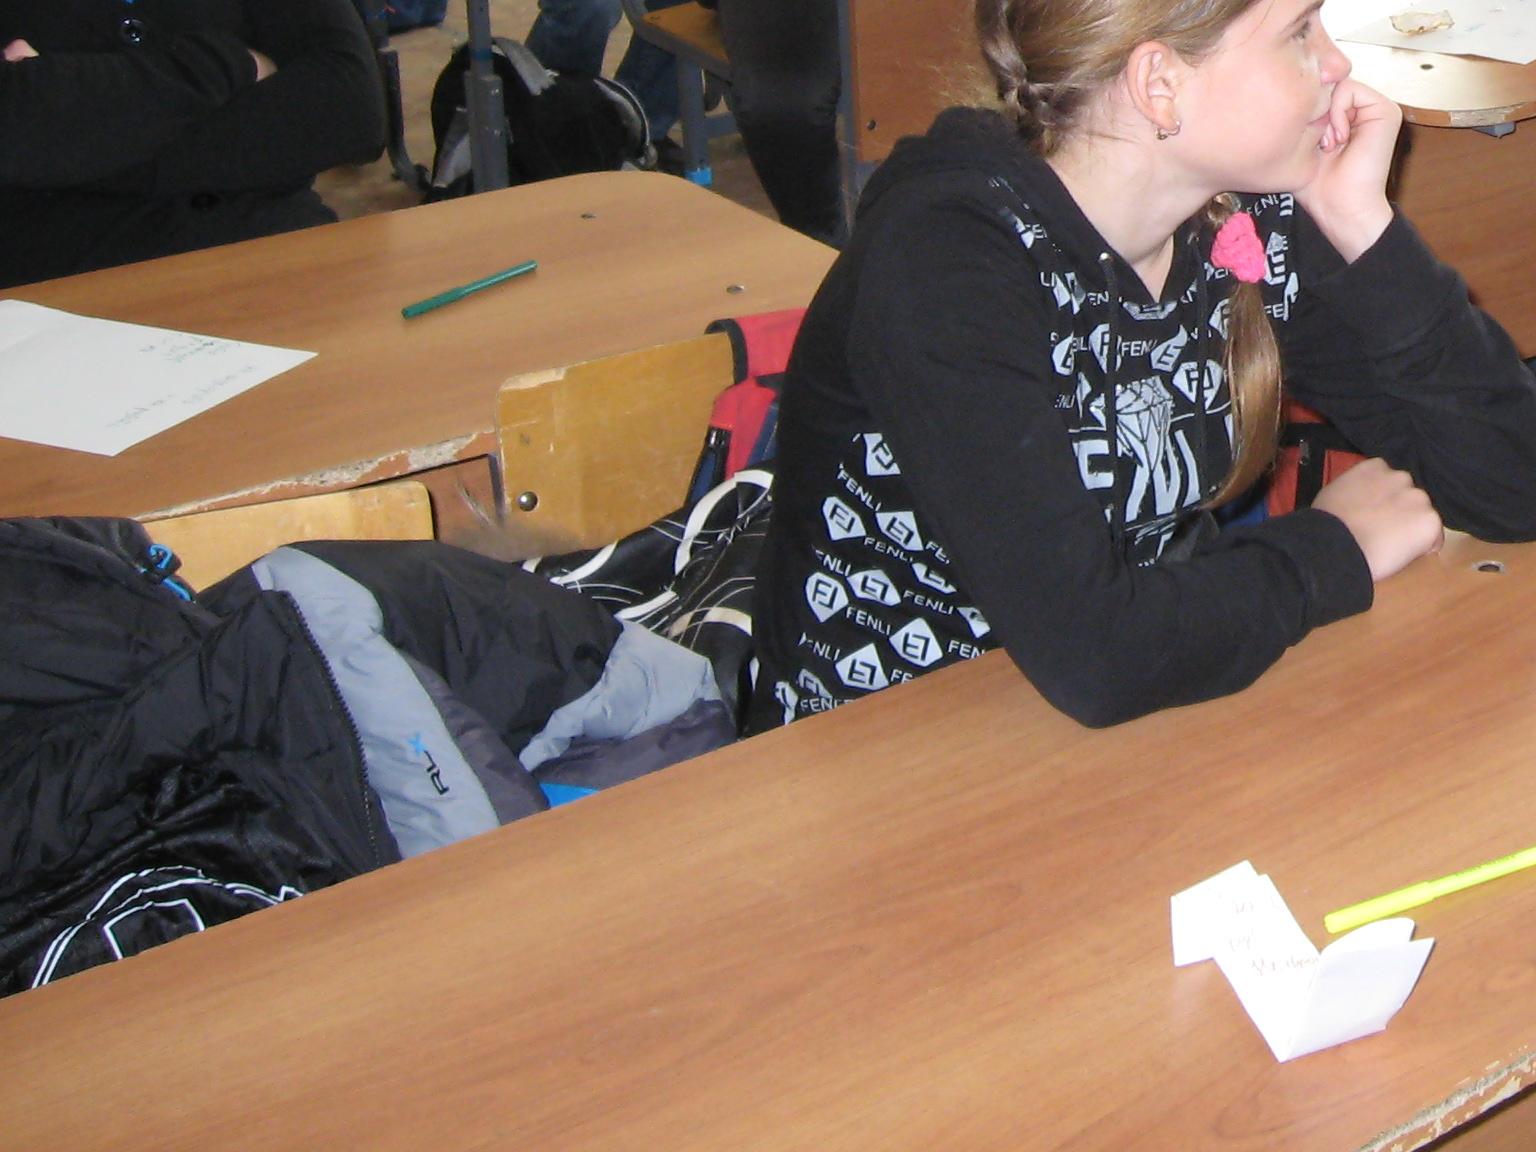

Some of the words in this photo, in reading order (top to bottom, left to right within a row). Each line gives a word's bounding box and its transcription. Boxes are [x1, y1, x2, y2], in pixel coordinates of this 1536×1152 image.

[837, 468, 882, 512] FENLI
[814, 549, 852, 577] NLI
[902, 589, 954, 615] FENLI
[845, 606, 891, 636] FENLI
[947, 639, 986, 659] FEN
